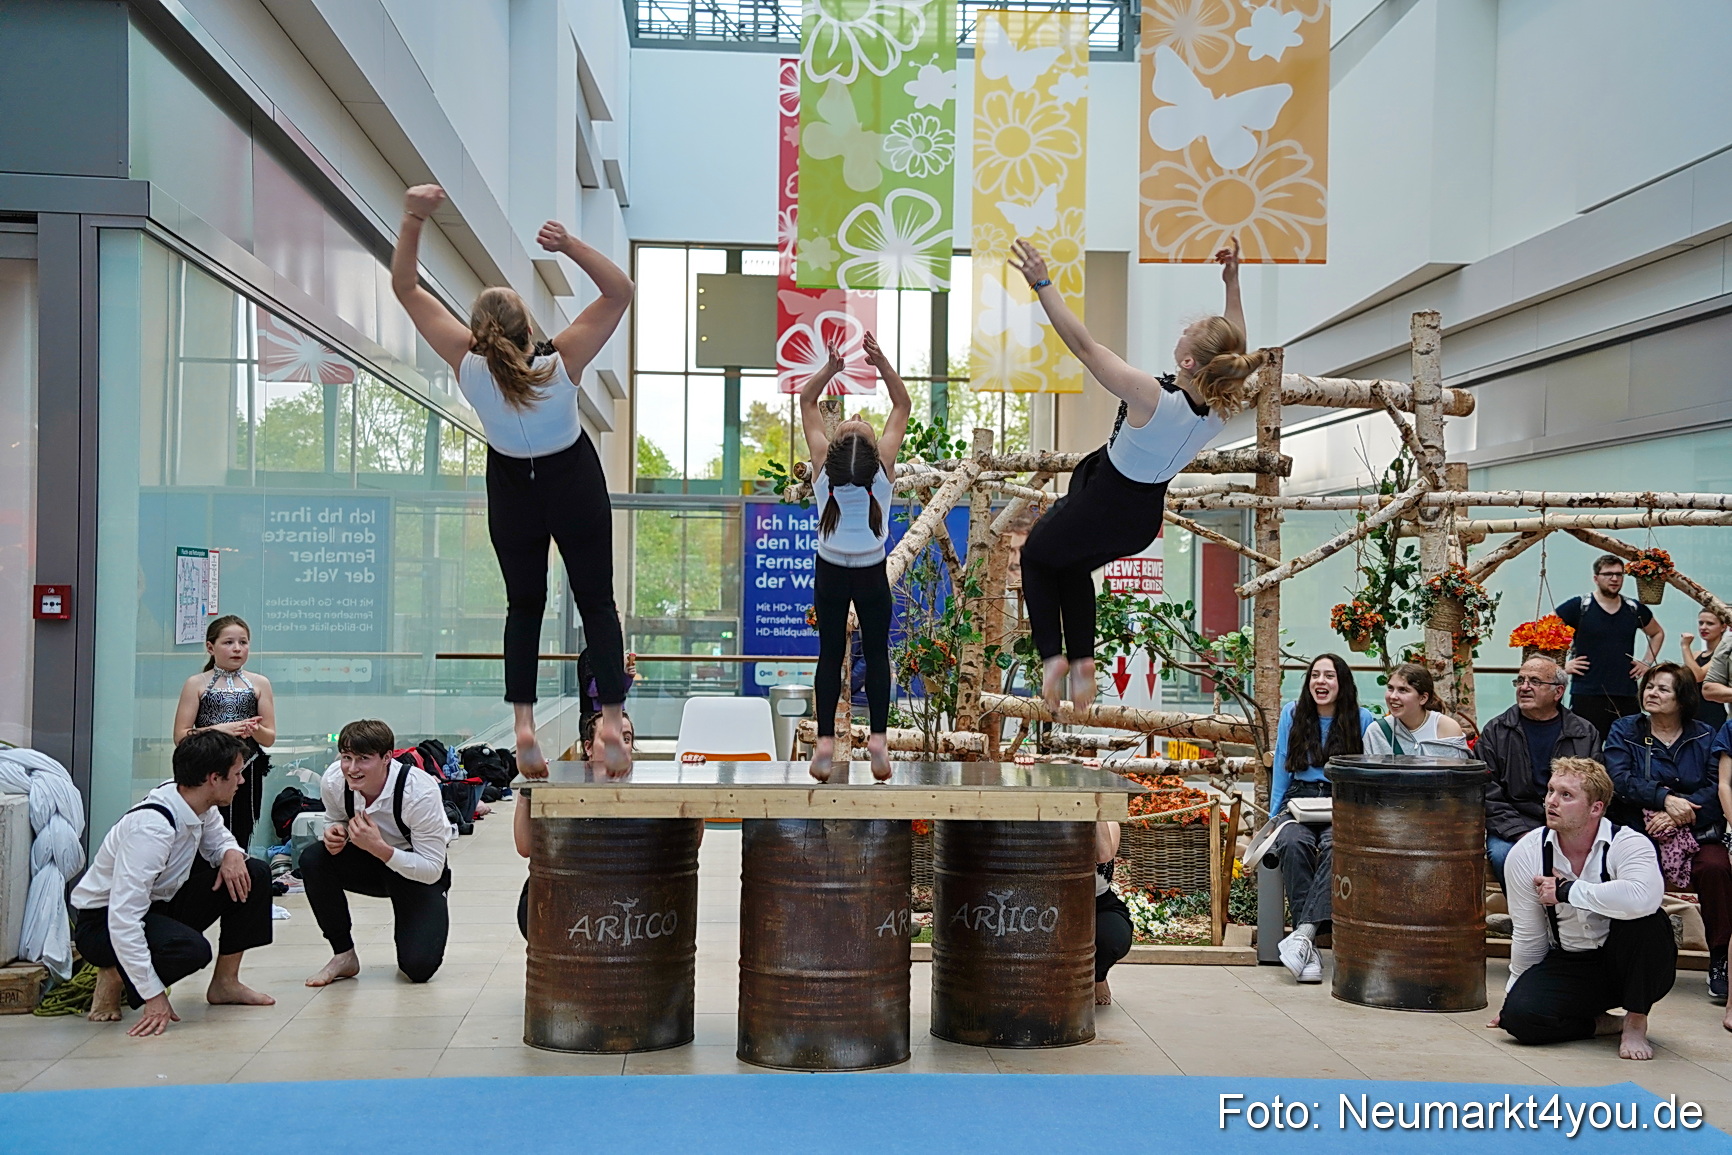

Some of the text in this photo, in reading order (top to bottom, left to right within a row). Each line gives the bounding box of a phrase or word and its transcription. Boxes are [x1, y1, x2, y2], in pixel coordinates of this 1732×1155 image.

[756, 513, 783, 531] Ich
[755, 532, 790, 550] den
[1104, 560, 1163, 578] REWE REWE
[755, 571, 786, 589] der
[1110, 578, 1141, 591] ENTER
[756, 602, 771, 612] Mit
[772, 603, 793, 612] HD+
[755, 615, 804, 625] Fernsehen
